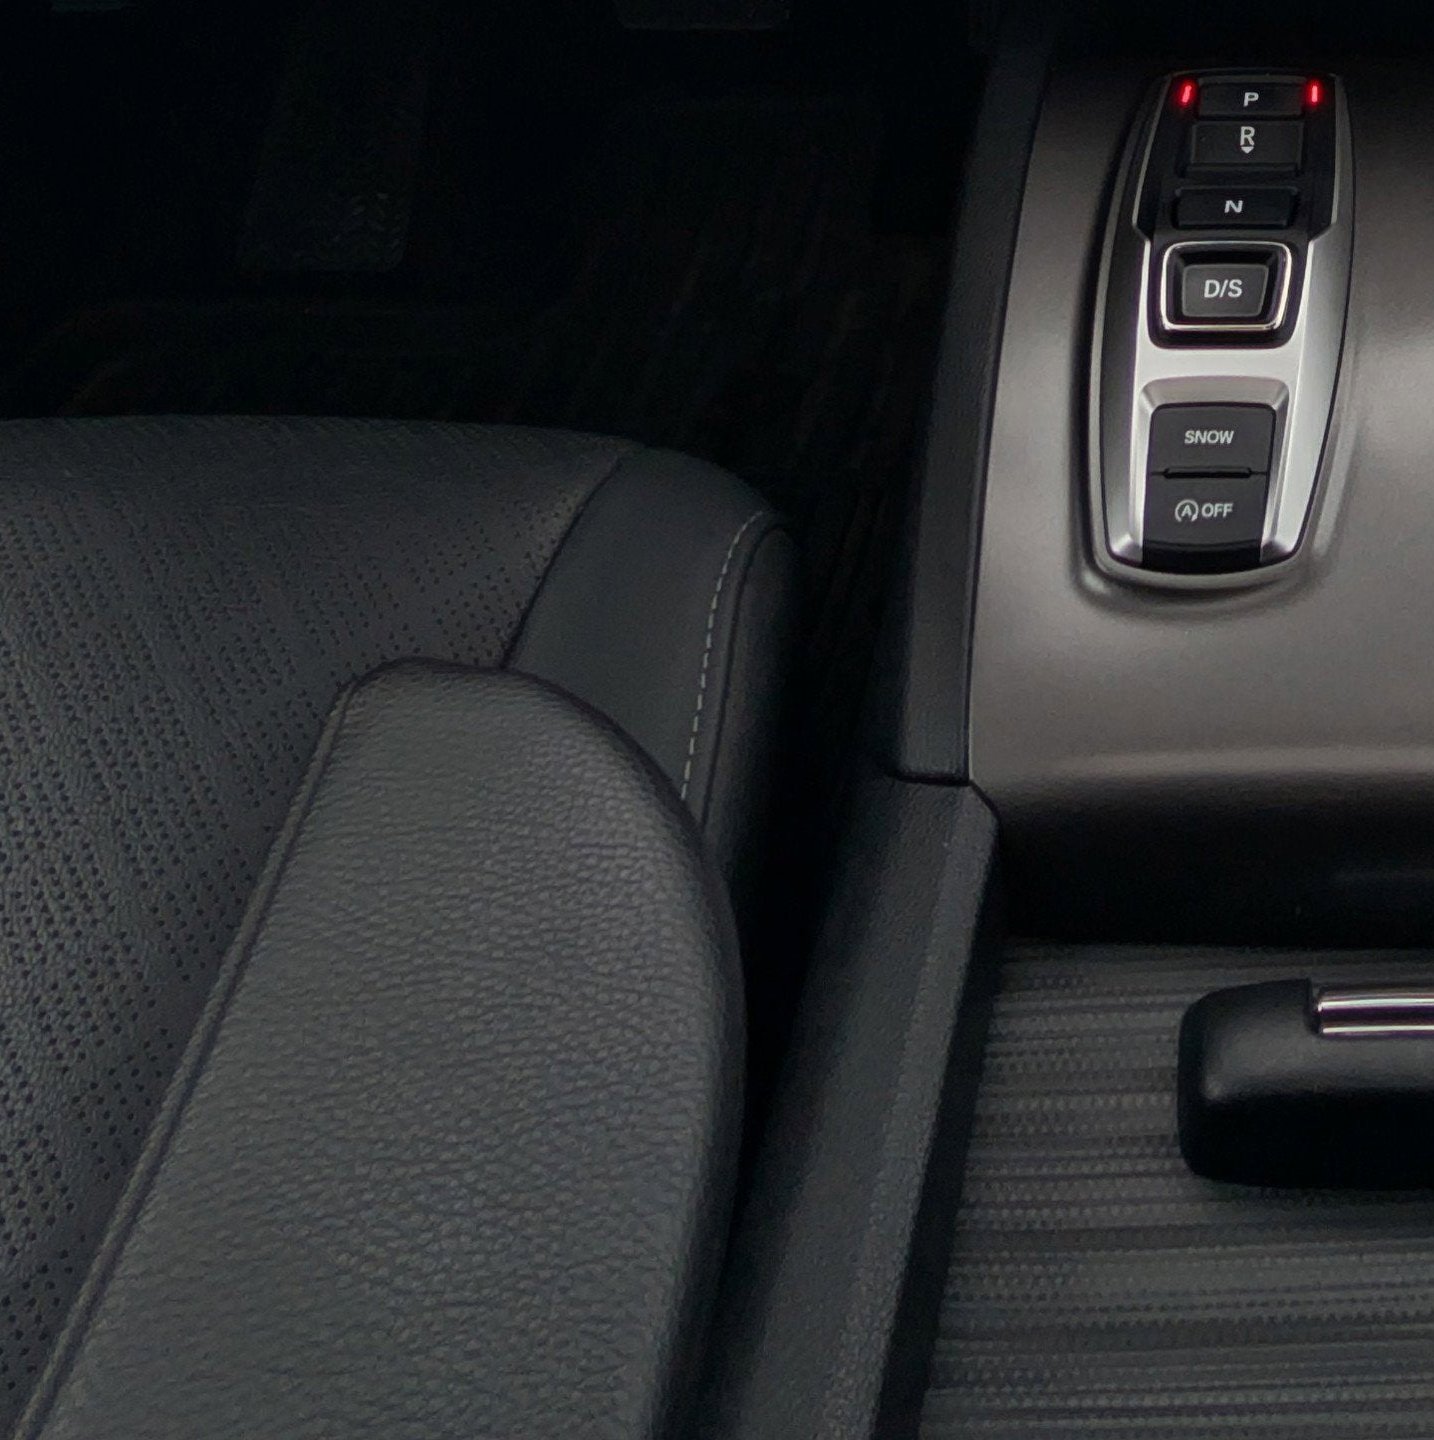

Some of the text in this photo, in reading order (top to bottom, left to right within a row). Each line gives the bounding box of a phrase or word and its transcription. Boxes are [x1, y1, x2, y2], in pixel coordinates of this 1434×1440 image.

[1243, 90, 1259, 107] P
[1239, 125, 1256, 146] R
[1223, 199, 1244, 214] N
[1202, 278, 1243, 299] D/S
[1183, 429, 1235, 445] SNOW
[1201, 502, 1235, 519] OFF
